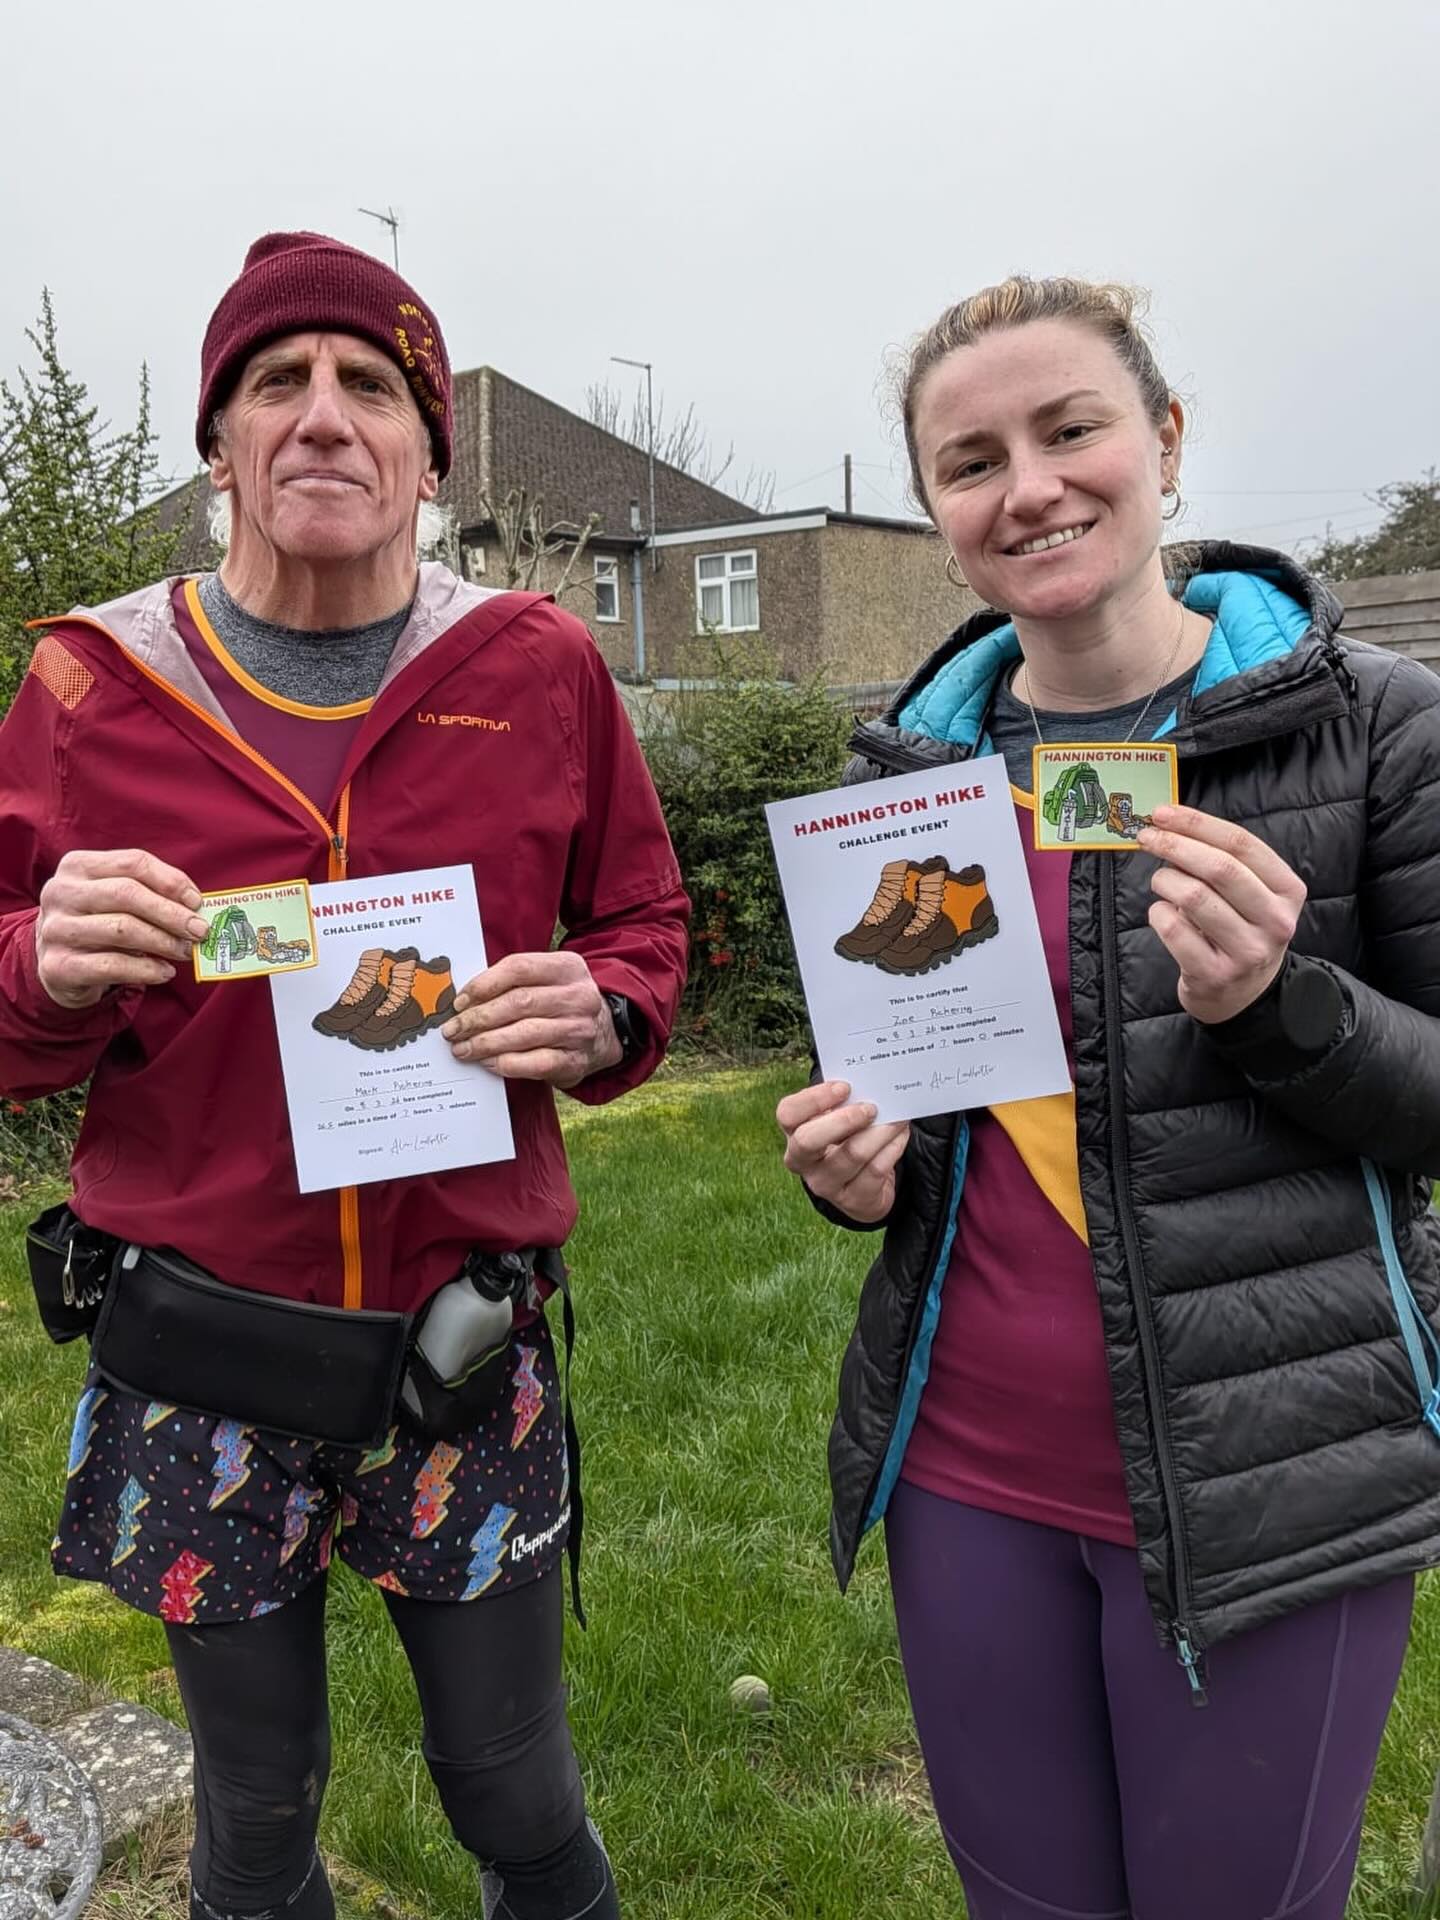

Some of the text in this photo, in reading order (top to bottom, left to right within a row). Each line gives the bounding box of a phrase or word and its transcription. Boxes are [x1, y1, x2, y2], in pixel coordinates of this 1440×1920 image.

[417, 712, 511, 731] LA SPORTIVA
[1044, 751, 1167, 762] HANNINGTON HIKE
[794, 784, 986, 837] HANNINGTON HIKE
[1063, 807, 1073, 839] WATER
[838, 819, 950, 850] CHALLENGE EVENT
[274, 886, 302, 898] HIKE
[312, 888, 456, 918] NNINGTON HIKE
[322, 915, 423, 936] CHALLENGE EVENT
[889, 998, 906, 1006] This
[916, 993, 925, 1001] to
[926, 988, 951, 998] certify
[952, 985, 968, 994] that
[876, 1036, 888, 1044] On
[940, 1023, 954, 1032] has
[956, 1015, 997, 1030] completed
[869, 1051, 891, 1061] miles
[892, 1049, 900, 1057] in
[907, 1044, 926, 1055] time
[926, 1041, 935, 1050] of
[953, 1035, 976, 1046] hours
[993, 1027, 1025, 1038] minutes
[358, 1069, 374, 1078] This
[392, 1063, 415, 1073] certify
[415, 1060, 431, 1069] that
[337, 1119, 357, 1128] miles
[372, 1114, 390, 1122] time
[412, 1107, 433, 1116] hours
[448, 1100, 478, 1110] minutes
[344, 1104, 355, 1113] On
[402, 1096, 416, 1104] has
[416, 1089, 454, 1103] completed
